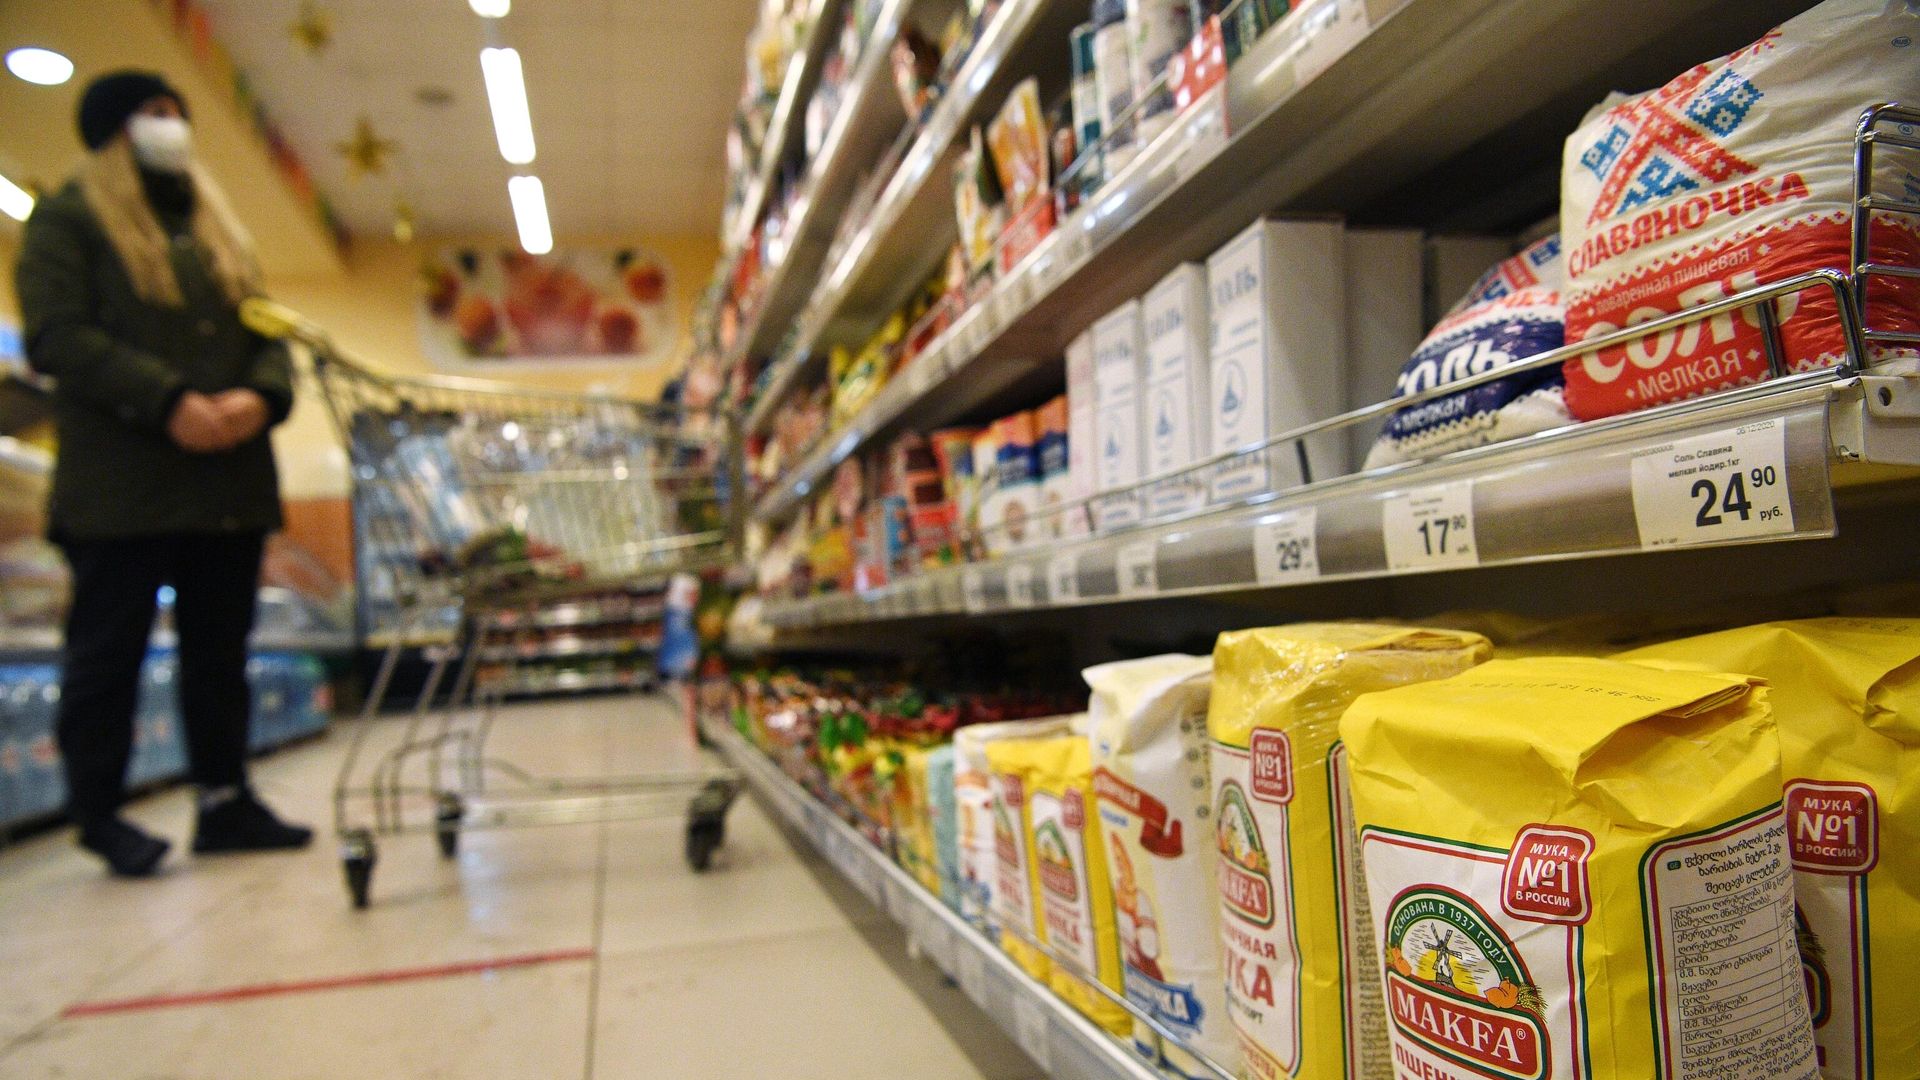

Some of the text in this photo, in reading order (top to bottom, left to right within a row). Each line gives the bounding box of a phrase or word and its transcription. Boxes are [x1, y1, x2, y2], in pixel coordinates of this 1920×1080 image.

[1569, 172, 1809, 279] СЛАВЯНОЧКА
[1674, 248, 1750, 286] пищевая
[1637, 348, 1742, 400] мелкая
[1674, 445, 1733, 464] Соль Славяна
[1691, 465, 1776, 528] 24 90
[1760, 506, 1783, 521] руб.
[1418, 519, 1449, 556] 17
[1277, 540, 1301, 571] 29
[1803, 797, 1852, 812] МУКА
[1797, 811, 1856, 845] №1
[1530, 843, 1569, 857] МУКА
[1767, 844, 1772, 855] 2
[1796, 843, 1857, 858] В РОССИИ
[1518, 857, 1569, 893] №1
[1516, 890, 1570, 907] В РОССИИ
[1394, 900, 1507, 964] ОСНОВАНА В 1937 ГОДУ
[1395, 986, 1523, 1064] MAKFA
